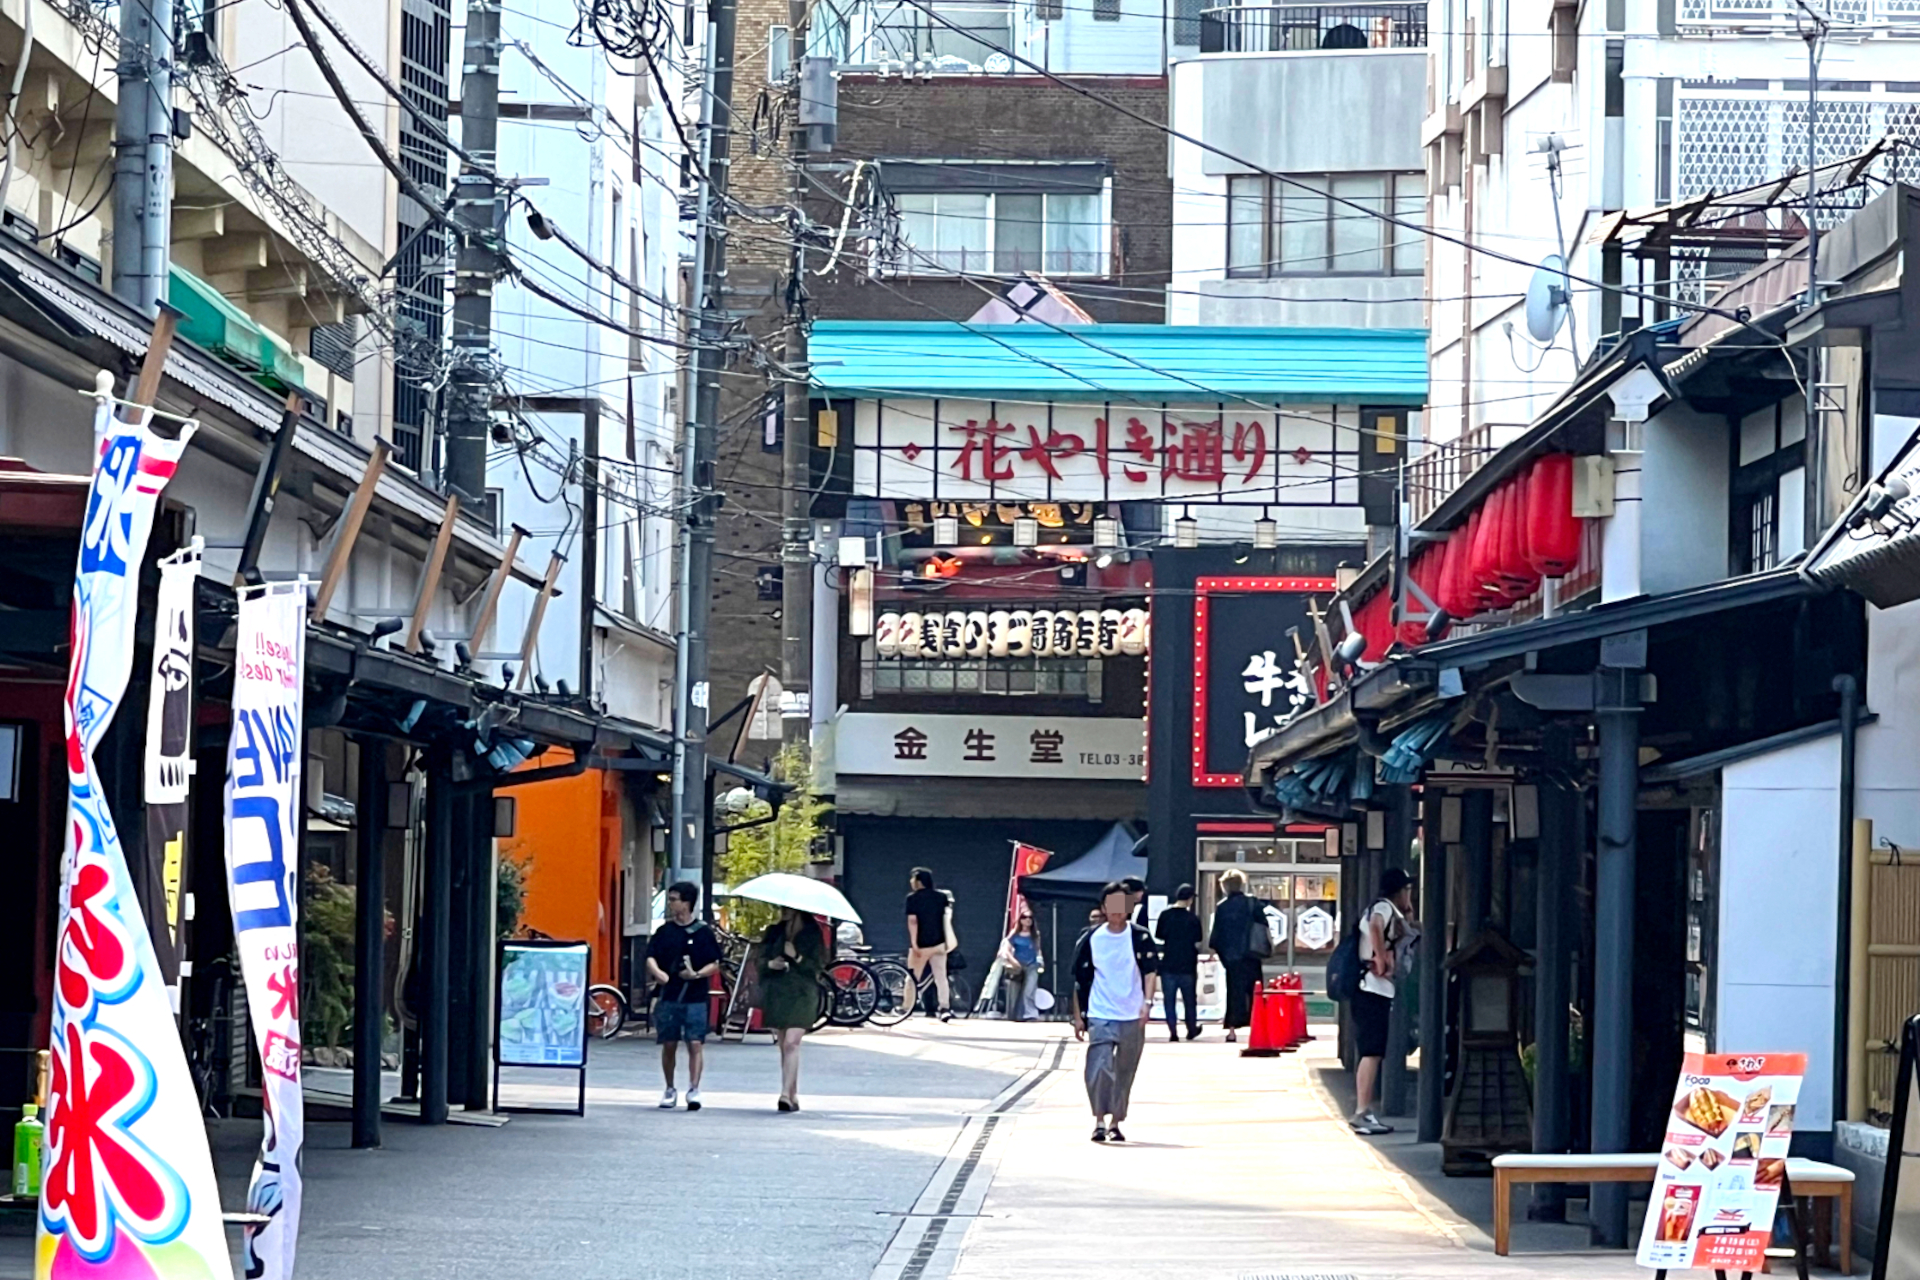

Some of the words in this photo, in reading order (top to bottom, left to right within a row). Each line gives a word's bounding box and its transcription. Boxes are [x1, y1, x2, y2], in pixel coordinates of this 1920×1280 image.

[949, 417, 1266, 484] 花やしき通り
[894, 726, 1064, 764] 金生堂
